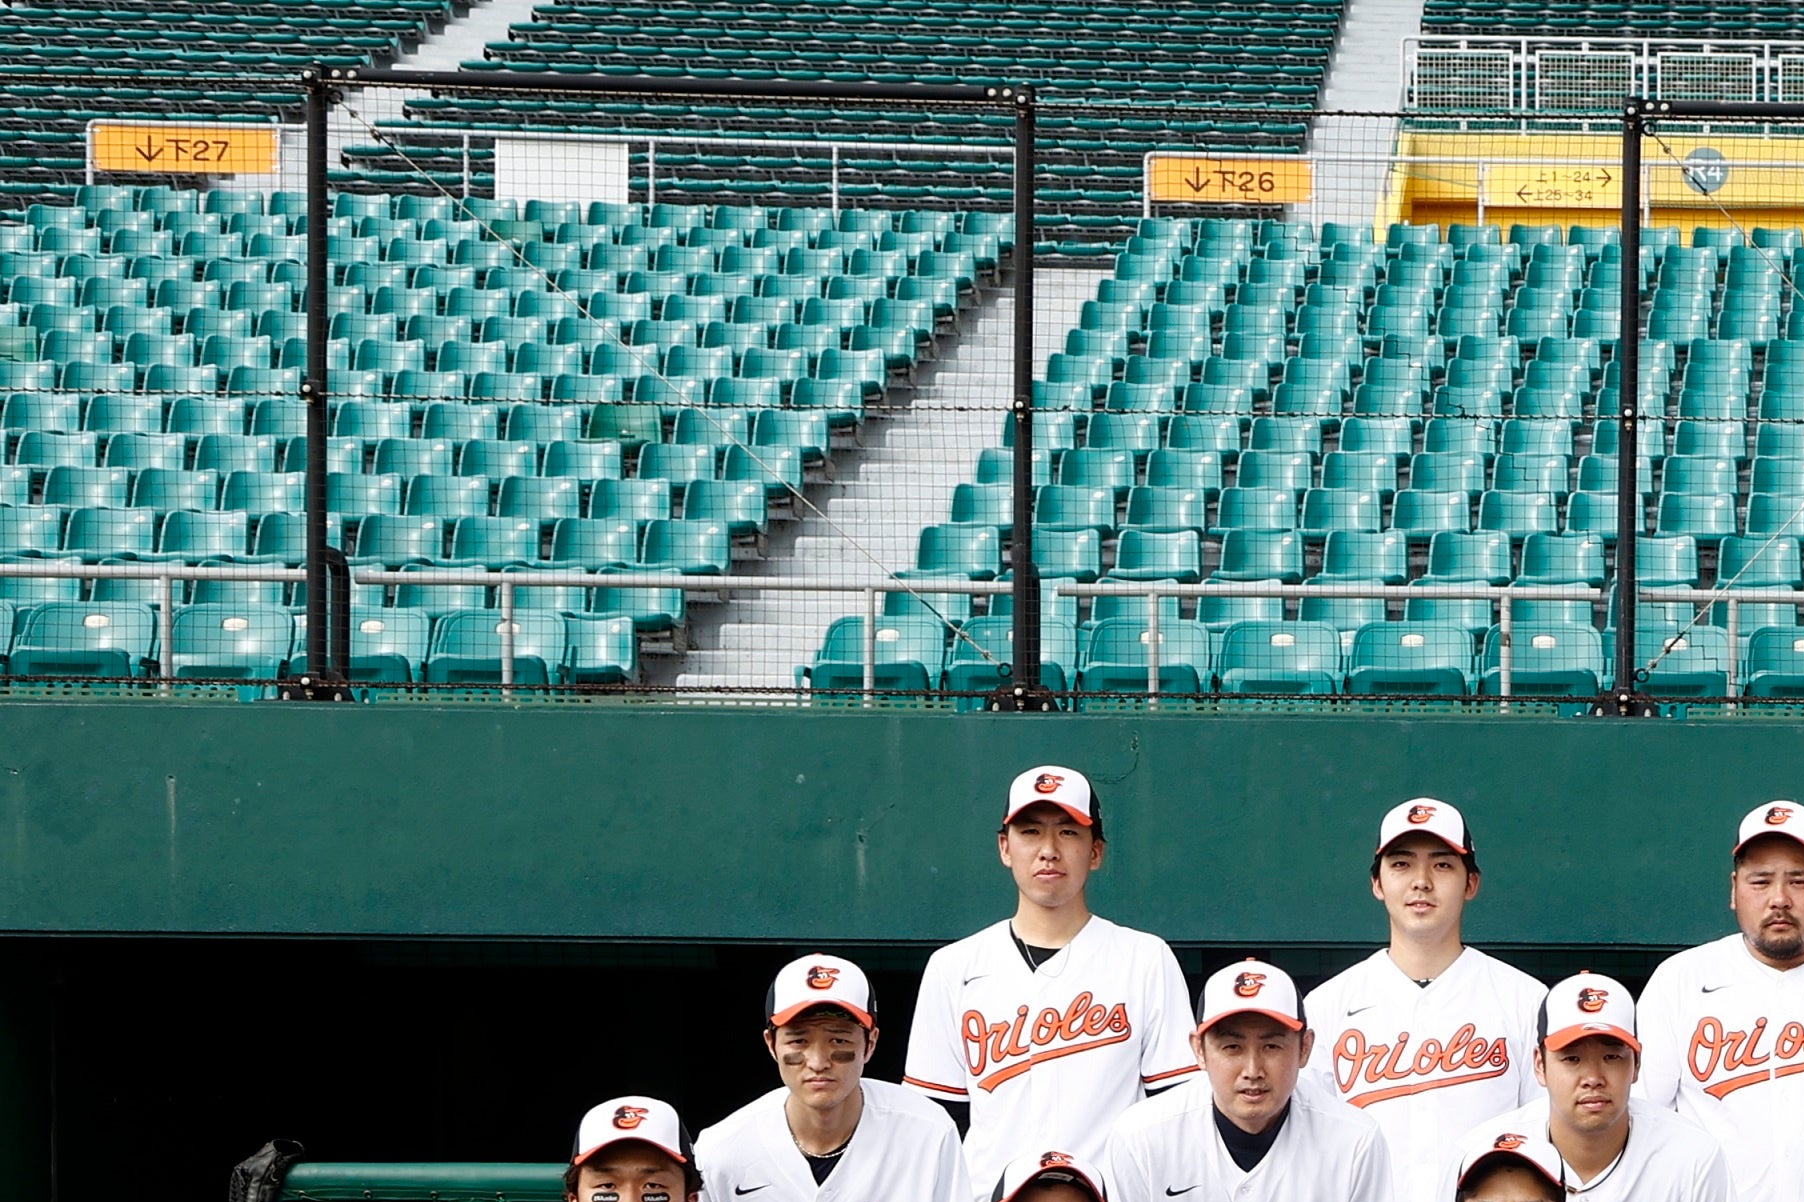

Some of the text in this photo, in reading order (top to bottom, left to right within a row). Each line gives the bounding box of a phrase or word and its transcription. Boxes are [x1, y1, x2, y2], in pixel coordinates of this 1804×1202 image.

[166, 139, 229, 162] 下27
[1213, 170, 1275, 193] 下26
[961, 991, 1132, 1077] Orioles
[1332, 1022, 1510, 1095] Orioles
